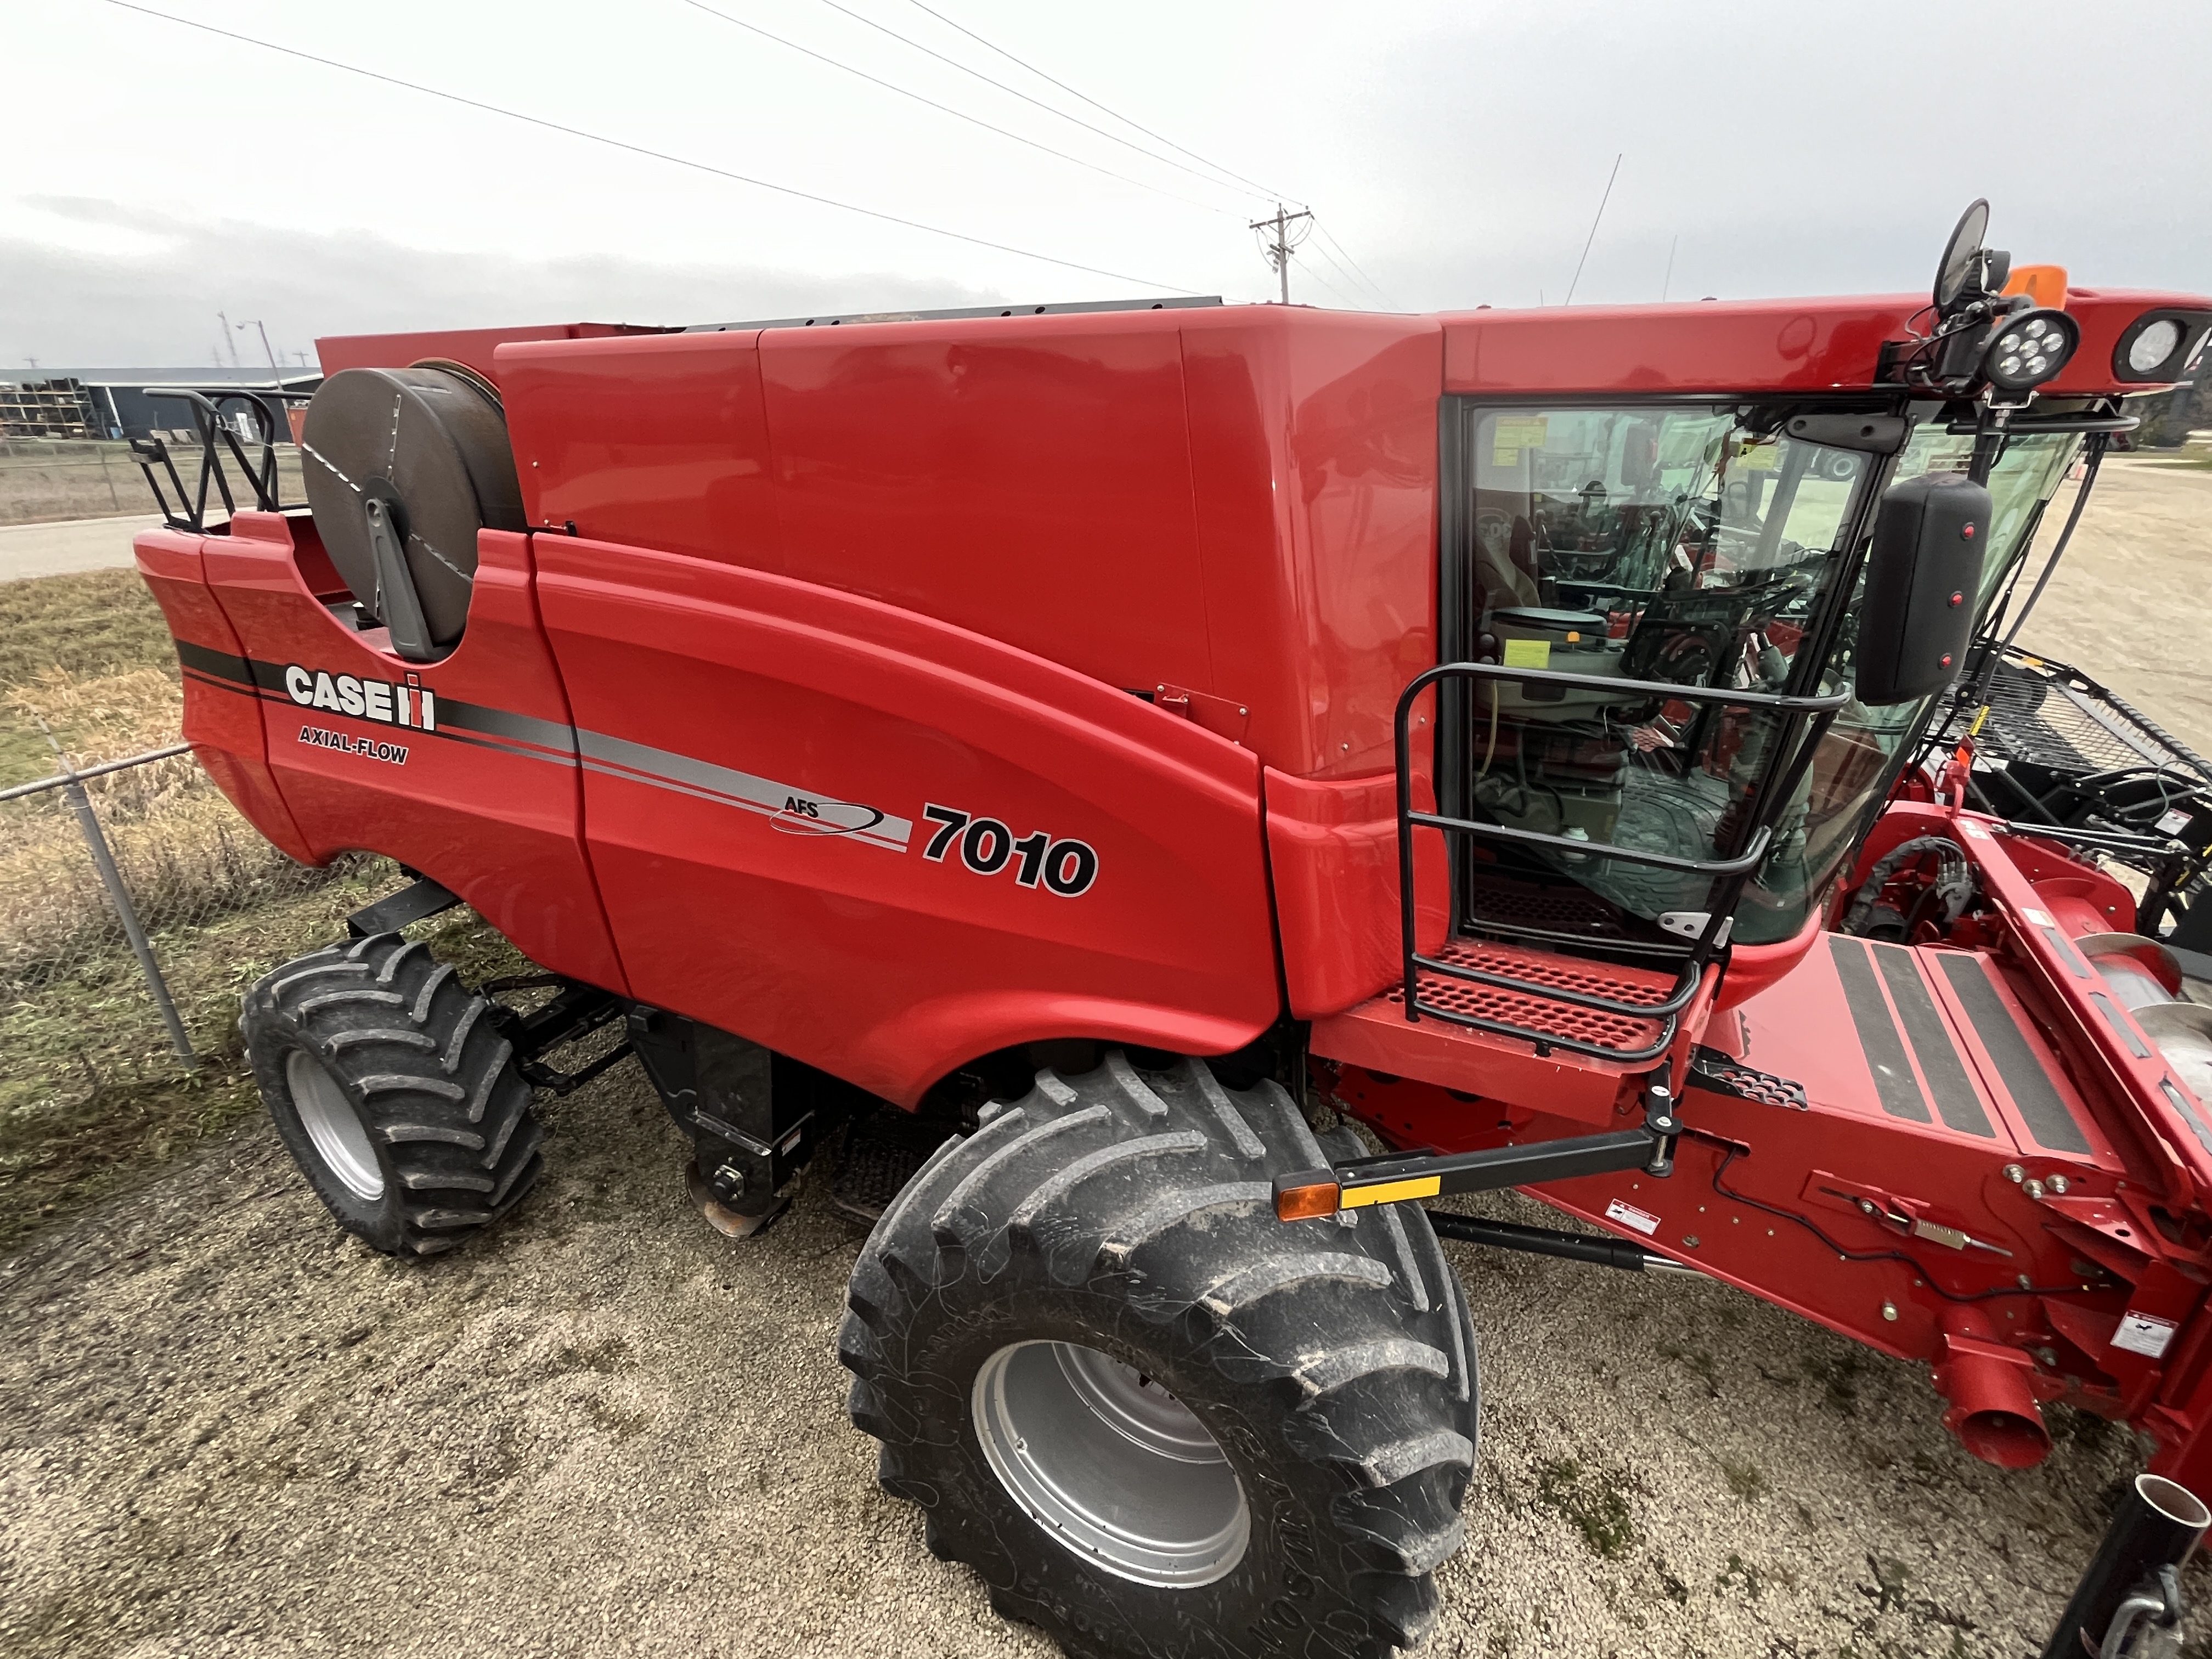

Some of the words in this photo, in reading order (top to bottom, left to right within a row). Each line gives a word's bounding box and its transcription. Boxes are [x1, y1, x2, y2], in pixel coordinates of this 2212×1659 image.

[285, 664, 393, 724] CASE
[298, 725, 409, 765] AXIAL-FLOW
[784, 795, 819, 819] AFS
[922, 802, 1099, 898] 7010
